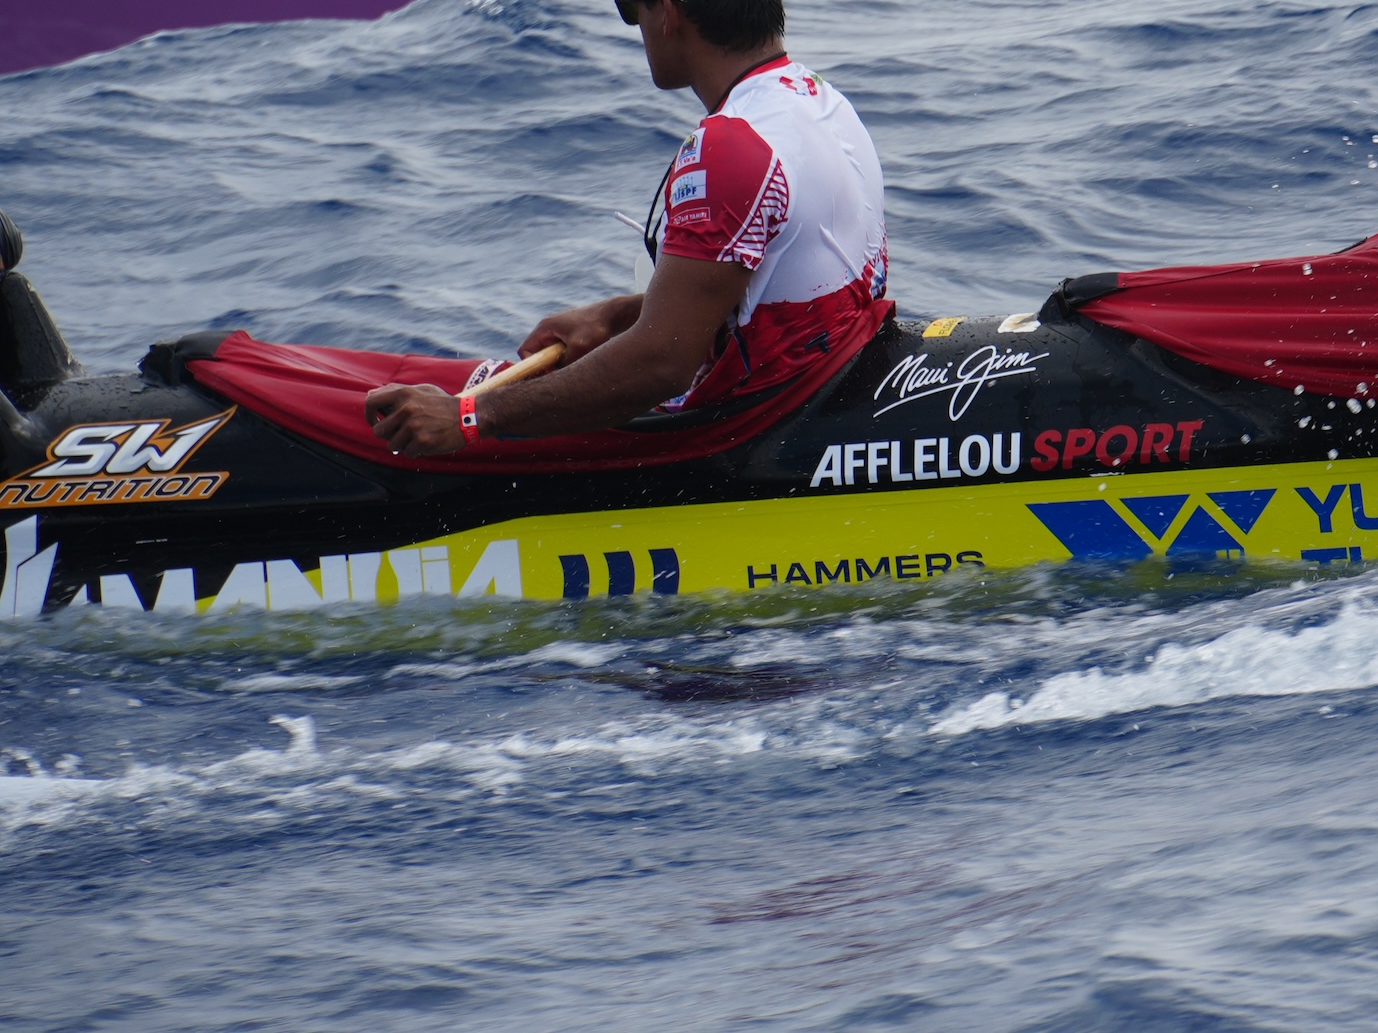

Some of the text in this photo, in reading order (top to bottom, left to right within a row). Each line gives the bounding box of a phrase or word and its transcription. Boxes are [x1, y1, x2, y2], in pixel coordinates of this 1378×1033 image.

[873, 345, 1050, 422] Maui Jim
[30, 418, 222, 478] SW
[810, 419, 1205, 488] AFFLELOU SPORT
[747, 550, 986, 590] HAMMERS
